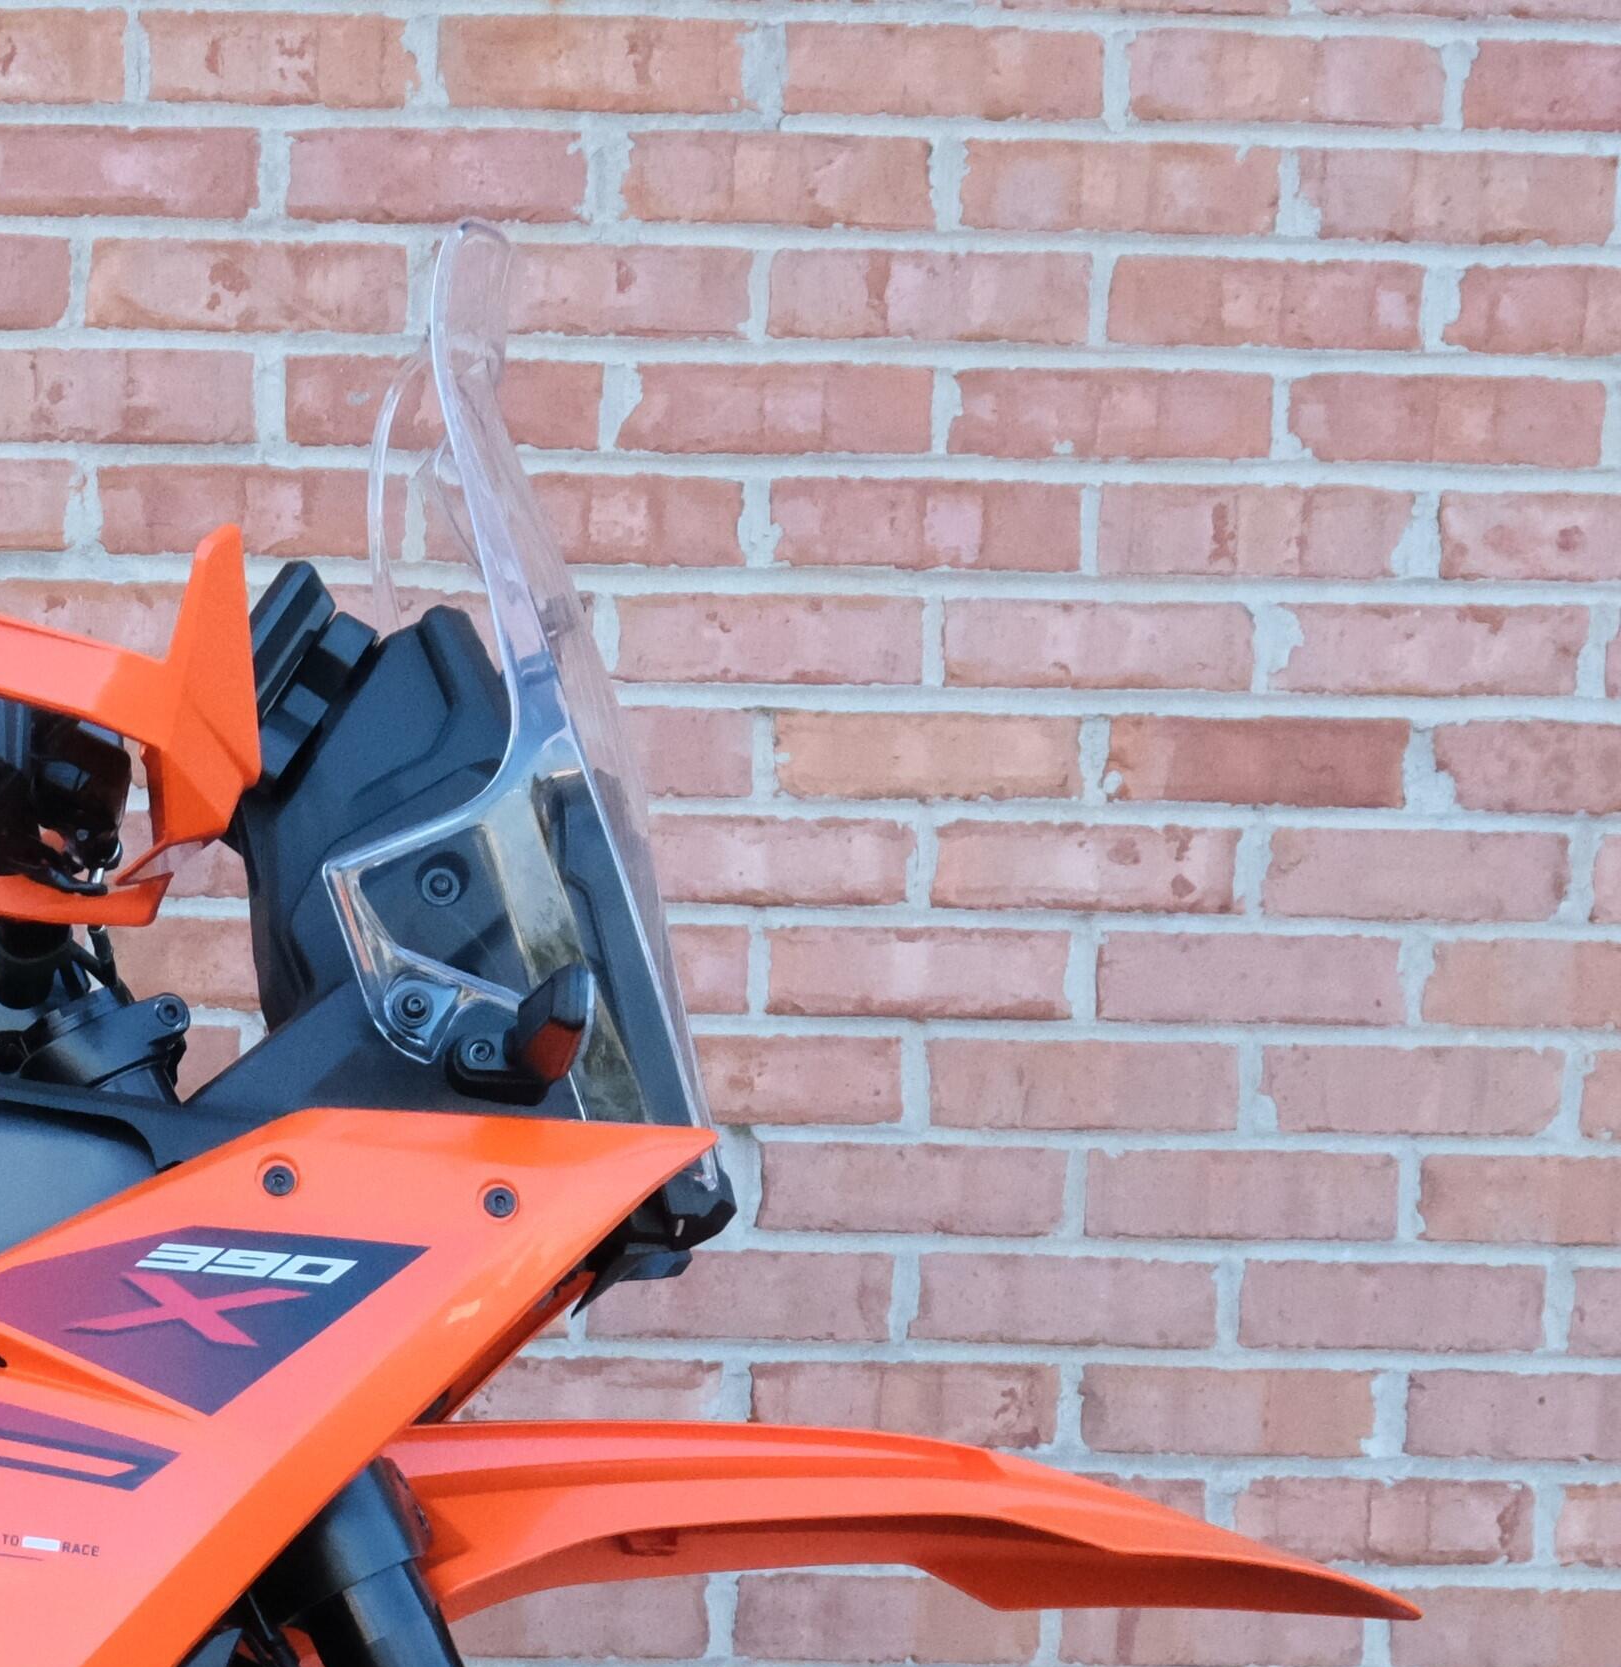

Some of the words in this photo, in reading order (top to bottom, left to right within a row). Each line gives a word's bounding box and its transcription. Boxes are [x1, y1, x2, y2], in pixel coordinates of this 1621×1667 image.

[134, 1243, 358, 1284] 390
[65, 1271, 312, 1347] X
[2, 1533, 20, 1546] TO
[61, 1541, 100, 1557] RACE
